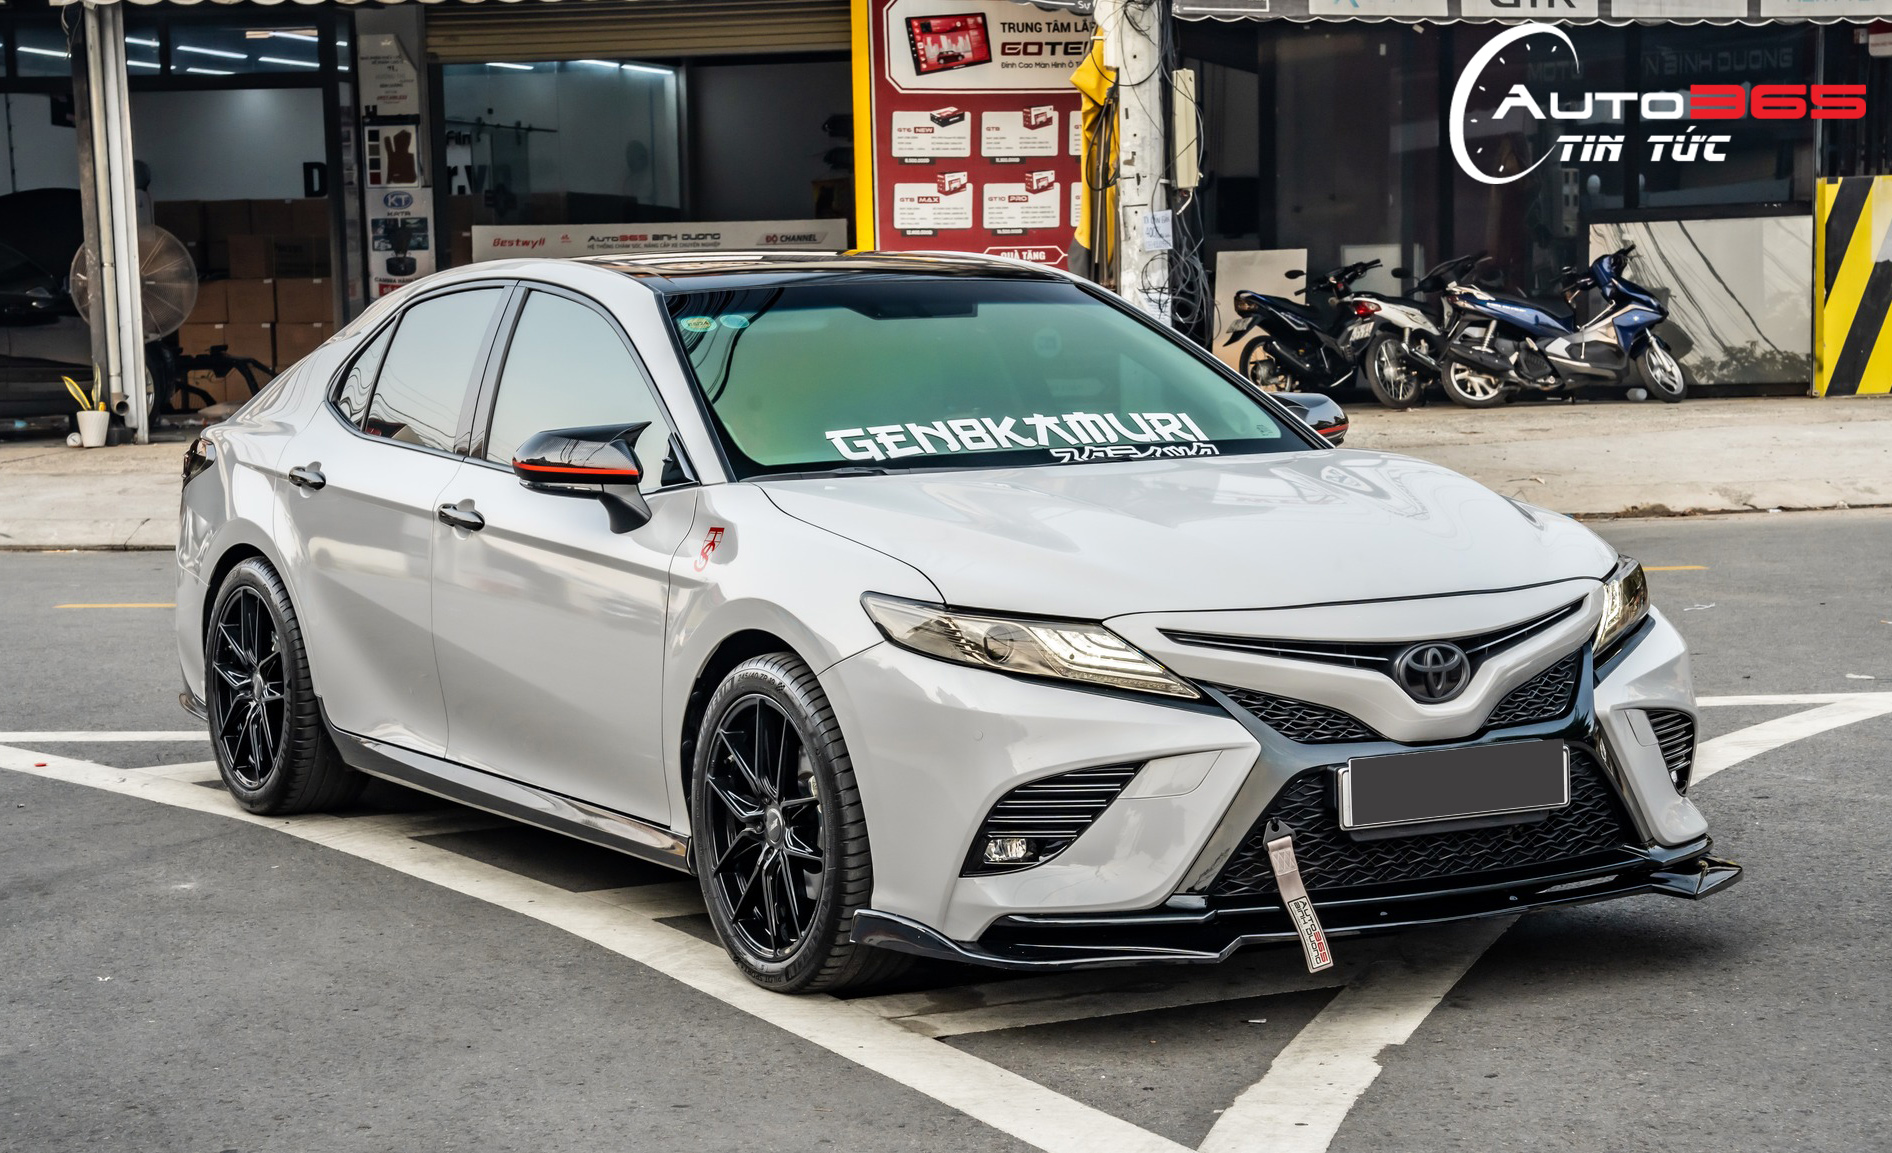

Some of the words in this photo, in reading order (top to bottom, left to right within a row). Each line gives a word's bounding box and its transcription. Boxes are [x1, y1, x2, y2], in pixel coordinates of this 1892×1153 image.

[1000, 22, 1042, 33] TRUNG
[1045, 19, 1071, 33] TÂM
[1001, 41, 1089, 56] GOTE
[1018, 61, 1033, 69] Cao
[387, 194, 408, 207] KT
[780, 233, 817, 243] CHANNEL
[1021, 249, 1046, 262] TẶNG
